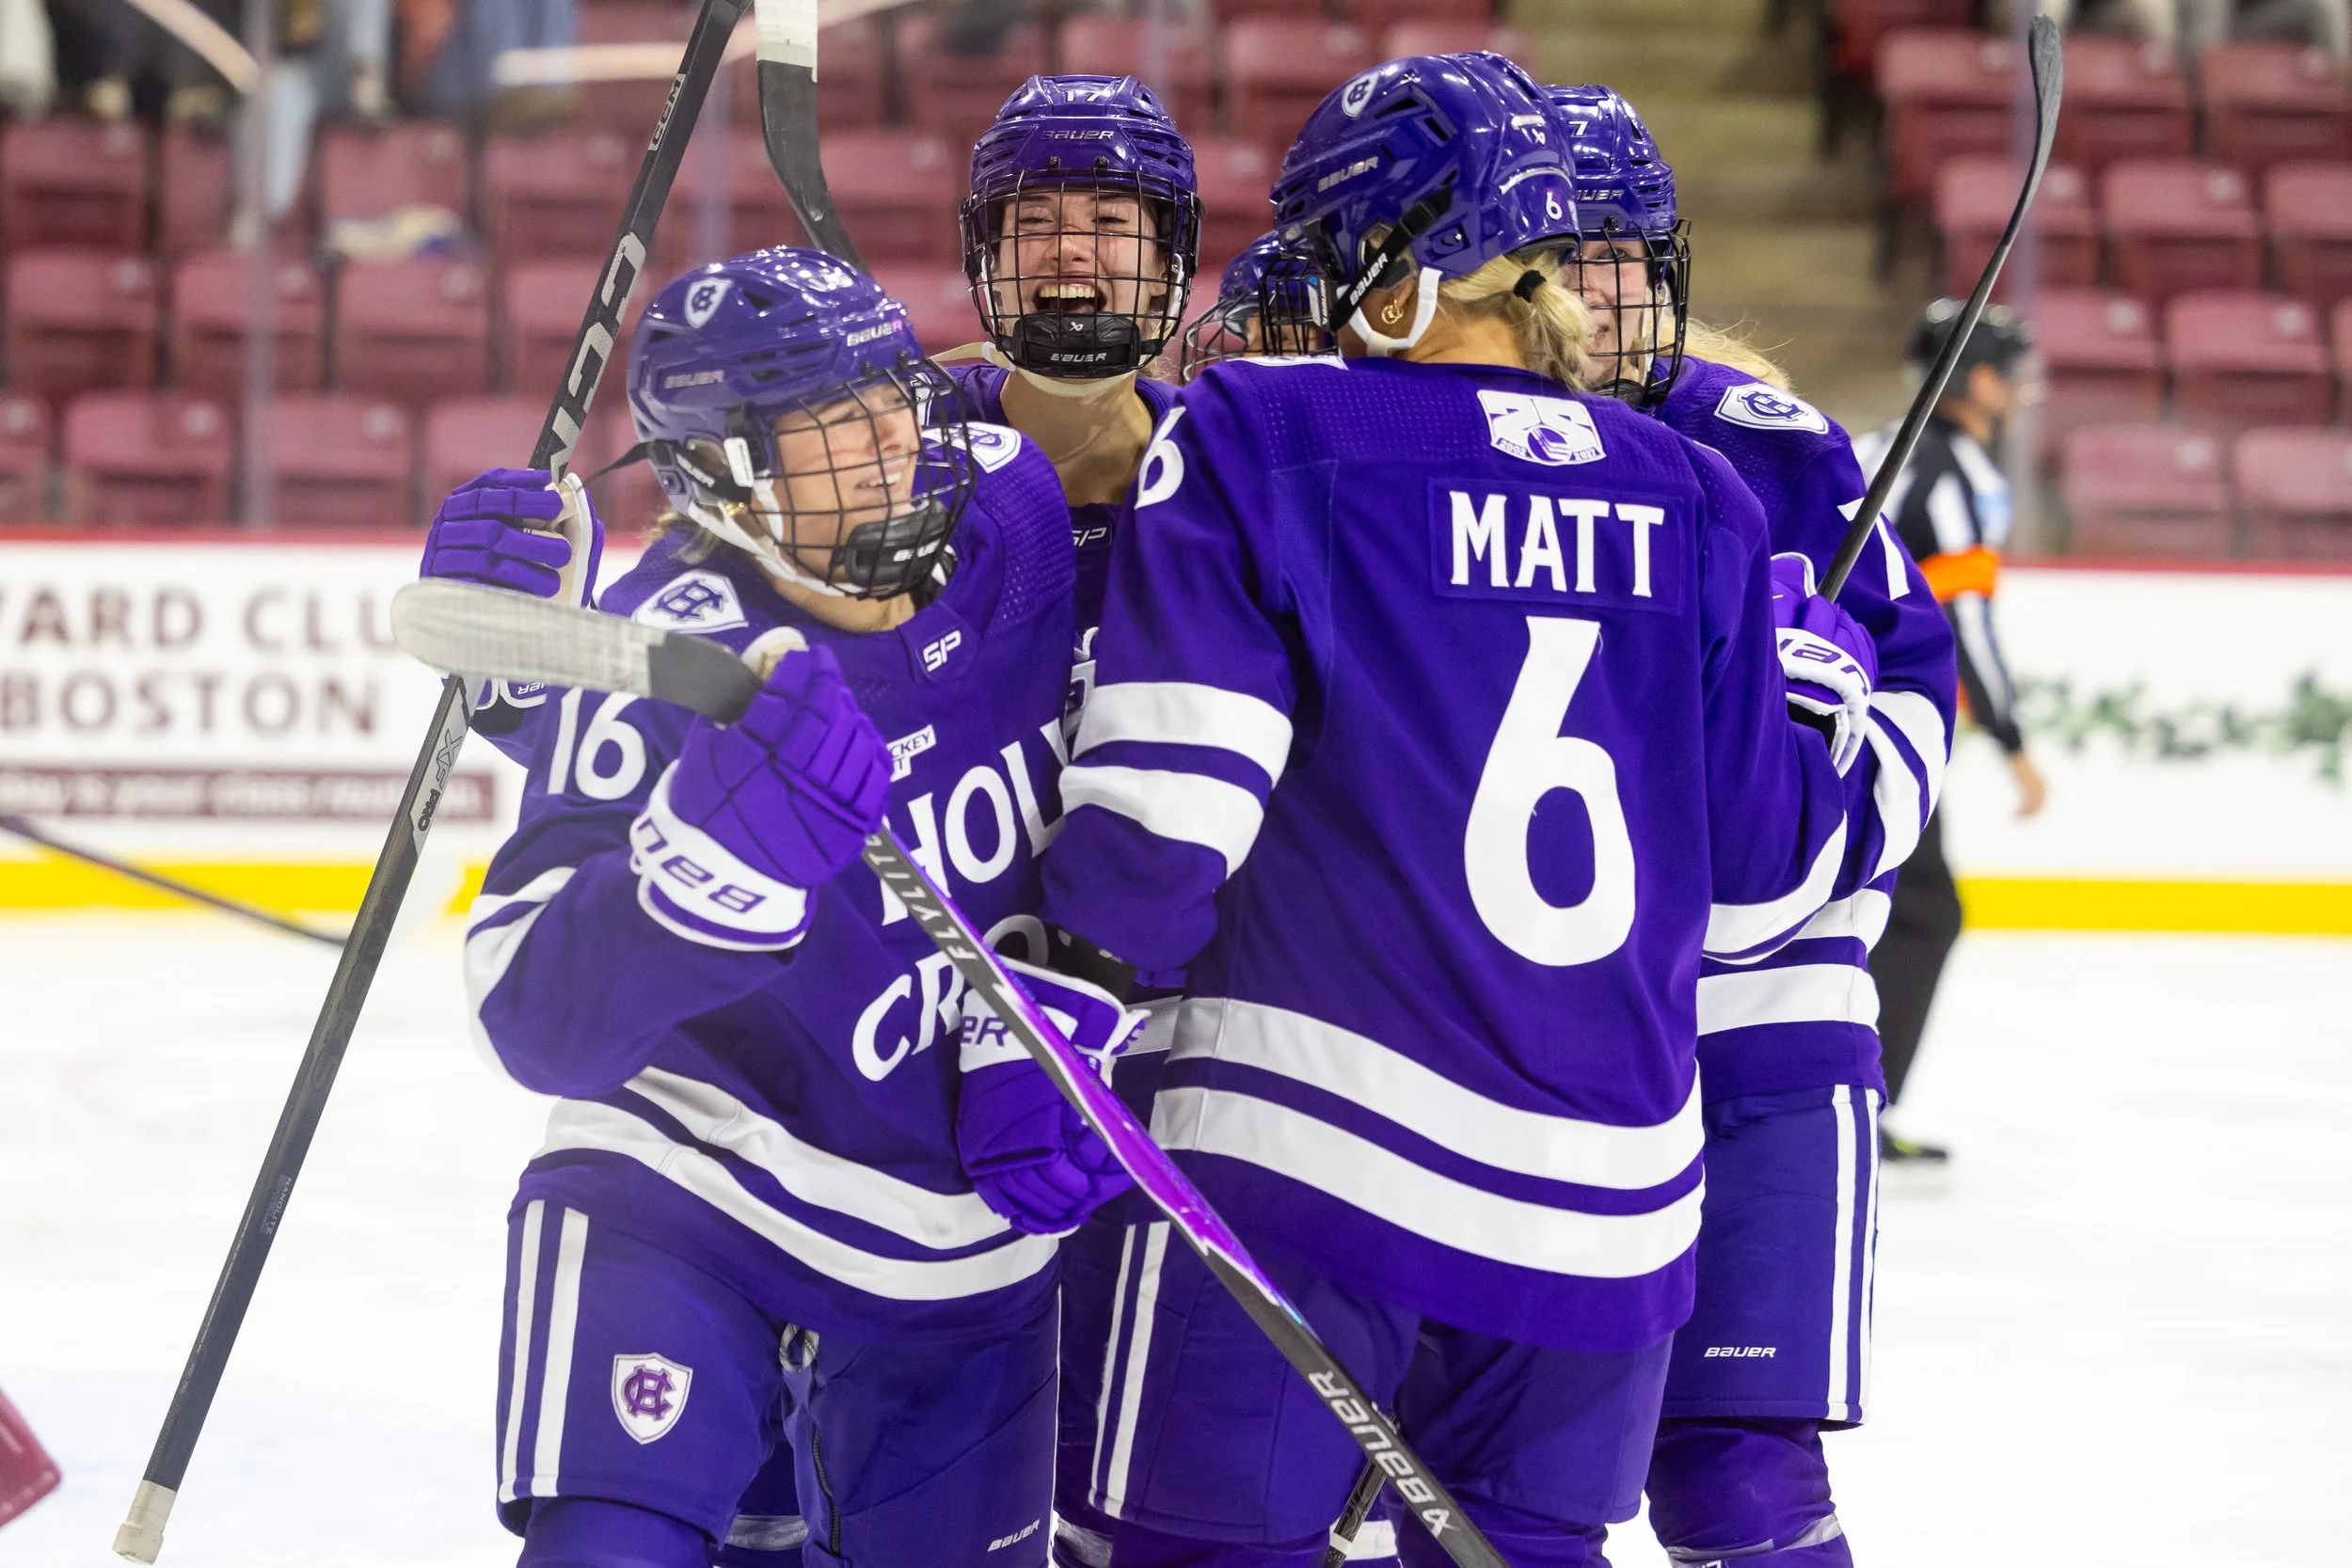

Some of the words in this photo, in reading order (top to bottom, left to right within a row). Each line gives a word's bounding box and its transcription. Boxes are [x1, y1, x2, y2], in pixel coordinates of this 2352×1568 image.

[653, 79, 681, 145] CCM
[1318, 156, 1378, 192] BAUER
[1577, 189, 1625, 201] UER
[1546, 191, 1563, 221] 6
[1349, 252, 1389, 306] BAUER
[847, 320, 903, 346] BAUER
[663, 370, 724, 389] BAUER
[1050, 352, 1107, 363] BAUER
[1135, 406, 1186, 510] 6
[1449, 490, 1665, 598] MATT
[0, 585, 203, 649] ARD
[242, 585, 399, 651] CLU
[923, 630, 961, 673] SP
[0, 668, 378, 741] BOSTON
[547, 687, 647, 800] 16
[889, 730, 930, 758] CKEY
[418, 788, 441, 832] PRO
[1464, 616, 1635, 967] 6
[882, 718, 1069, 927] HOL
[1703, 1346, 1777, 1358] BAUER
[1309, 1370, 1438, 1505] BAUER
[987, 1518, 1041, 1553] BAUER
